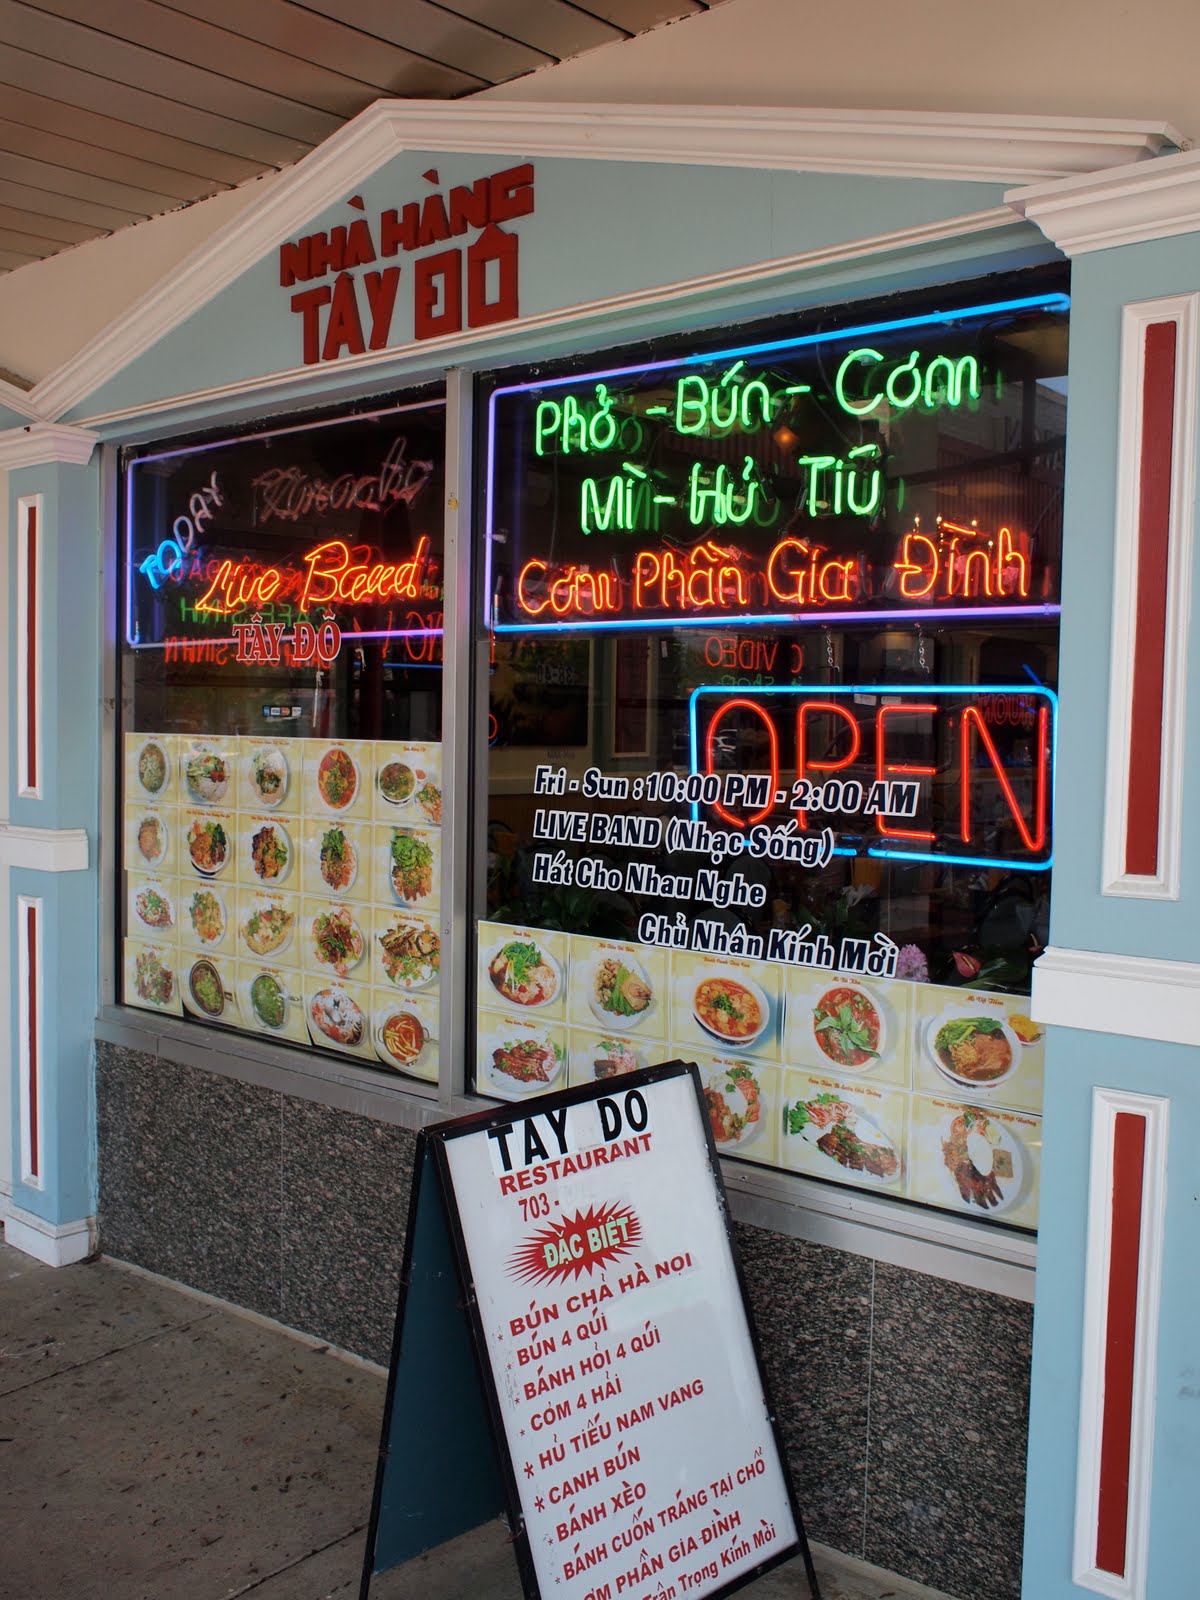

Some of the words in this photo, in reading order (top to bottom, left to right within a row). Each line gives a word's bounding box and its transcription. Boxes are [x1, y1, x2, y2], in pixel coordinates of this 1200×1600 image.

[280, 195, 377, 287] NHÀ
[381, 163, 534, 258] HÀNG
[291, 271, 401, 365] TÂY
[675, 360, 772, 435] Bún
[139, 470, 224, 590] TODAY
[767, 538, 855, 606] Gia
[893, 521, 1029, 599] Đình
[232, 612, 286, 662] TÂY
[292, 605, 342, 662] ĐÔ
[534, 765, 567, 796] Fri
[583, 767, 629, 800] Sun
[723, 774, 772, 808] PM
[790, 778, 862, 814] 2:00
[863, 780, 921, 818] AM
[705, 698, 1049, 852] OPEN
[533, 808, 589, 843] LIVE
[589, 812, 663, 849] BAND
[665, 815, 745, 866] (Nhạc
[749, 818, 836, 870] Sống)
[532, 850, 574, 886] Hát
[575, 856, 624, 892] Cho
[625, 862, 694, 900] Nhau
[694, 868, 768, 909] Nghe
[637, 911, 691, 951] Chủ
[691, 918, 765, 961] Nhân
[765, 922, 836, 970] Kính
[837, 931, 901, 979] Mời
[487, 1107, 569, 1173] TAY
[596, 1089, 649, 1142] DO
[499, 1132, 653, 1196] RESTAURANT
[543, 1229, 584, 1269] ĐẶC
[586, 1214, 629, 1254] BIỆT
[509, 1300, 560, 1337] BÚN
[565, 1272, 614, 1313] CHẢ
[618, 1262, 651, 1294] HÀ
[517, 1330, 557, 1366] BÚN
[561, 1330, 572, 1346] 4
[523, 1365, 576, 1400] BÁNH
[616, 1343, 627, 1359] 4
[569, 1413, 612, 1453] TIẾU
[616, 1401, 655, 1432] NAM
[657, 1378, 704, 1411] VANG
[576, 1393, 588, 1410] 4
[548, 1466, 600, 1504] CANH
[603, 1440, 641, 1477] BÚN
[556, 1503, 607, 1542] BÁNH
[610, 1480, 647, 1513] XÈO
[563, 1542, 608, 1580] BÁNH
[611, 1506, 655, 1553] CUỐN
[657, 1489, 708, 1526] TRÁNG
[615, 1547, 665, 1594] PHẦN
[668, 1536, 698, 1563] GIA
[698, 1509, 742, 1545] ĐÌNH
[677, 1561, 719, 1588] Trọng
[719, 1534, 751, 1568] Kính
